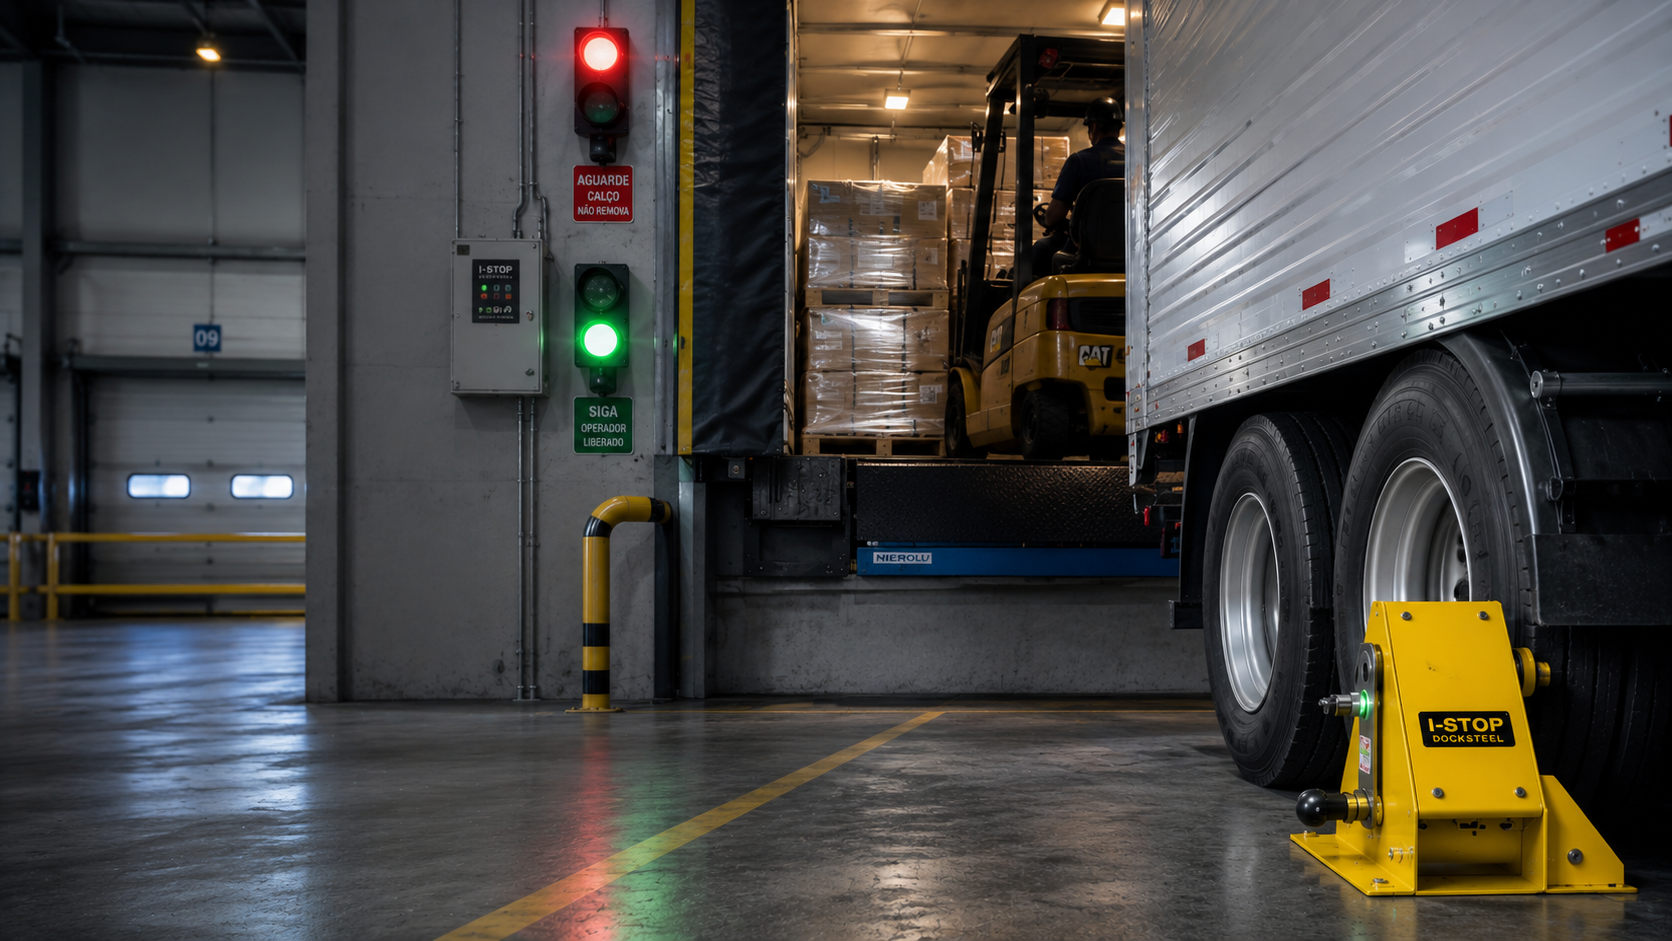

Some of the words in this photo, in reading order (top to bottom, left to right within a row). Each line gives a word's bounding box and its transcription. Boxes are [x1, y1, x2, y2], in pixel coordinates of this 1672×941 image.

[577, 174, 630, 186] AGUARDE
[588, 191, 620, 204] CALÇO
[596, 206, 630, 216] REMOVA
[479, 265, 512, 274] I-STOP
[196, 330, 218, 348] 09
[1078, 345, 1111, 366] CAT
[589, 406, 618, 418] SIGA
[581, 424, 626, 432] OPERADOR
[584, 438, 624, 446] LIBERADO
[1428, 718, 1504, 732] I-STOP
[1432, 734, 1504, 742] DOCKSTEEL
